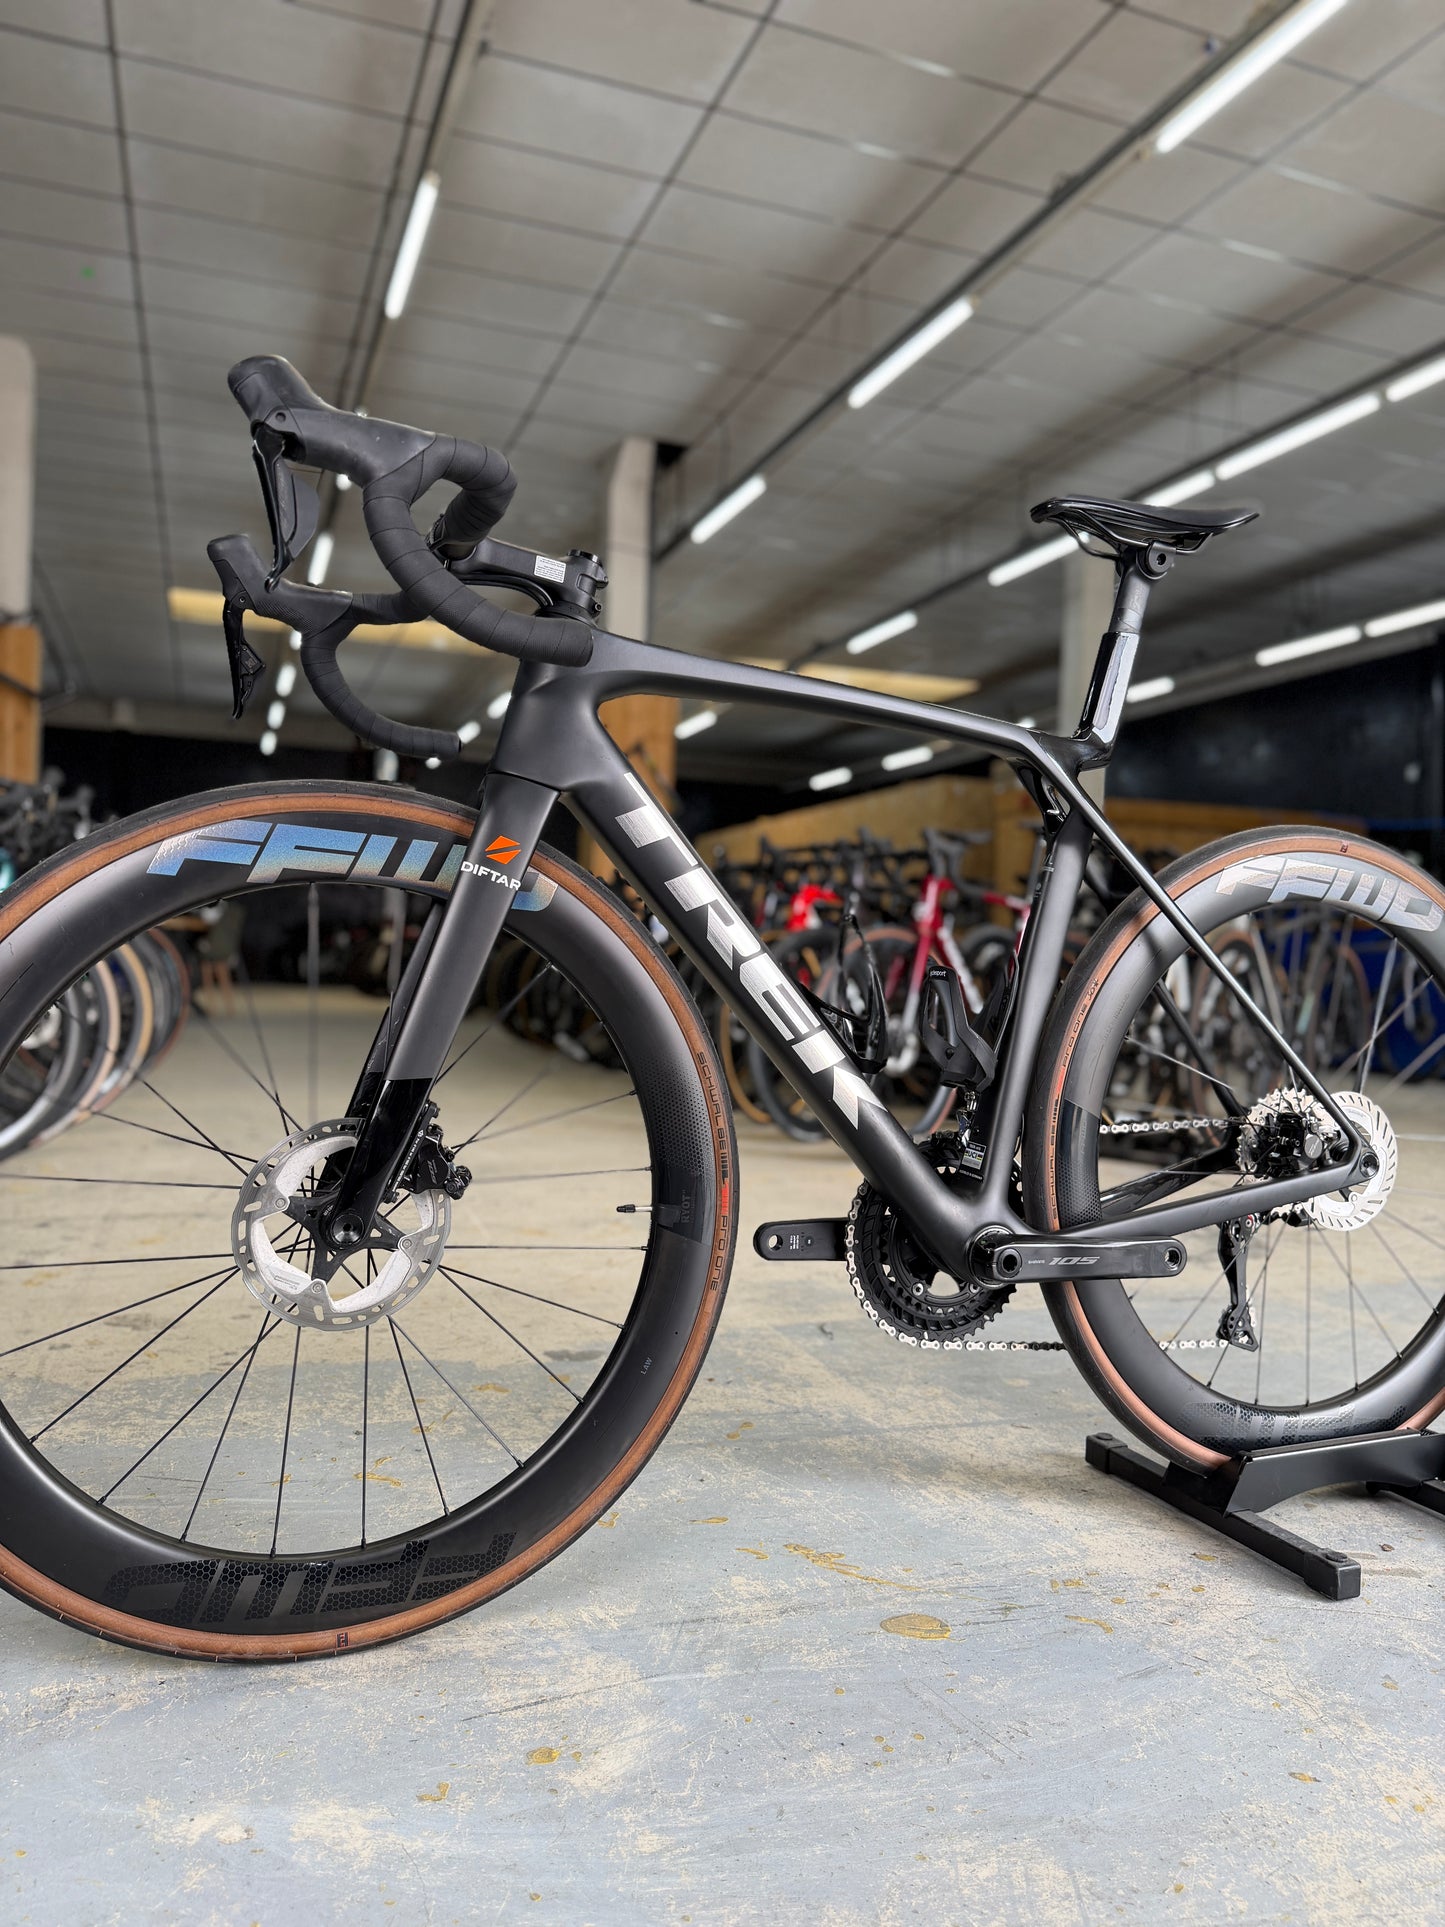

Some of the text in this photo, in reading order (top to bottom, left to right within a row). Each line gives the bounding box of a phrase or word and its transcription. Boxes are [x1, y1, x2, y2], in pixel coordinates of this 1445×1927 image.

[460, 861, 521, 891] DIFTAR
[1215, 854, 1444, 932] FFWD
[615, 772, 888, 1130] TREK
[697, 1051, 727, 1151] SCHWALBE
[1048, 1256, 1100, 1266] 105
